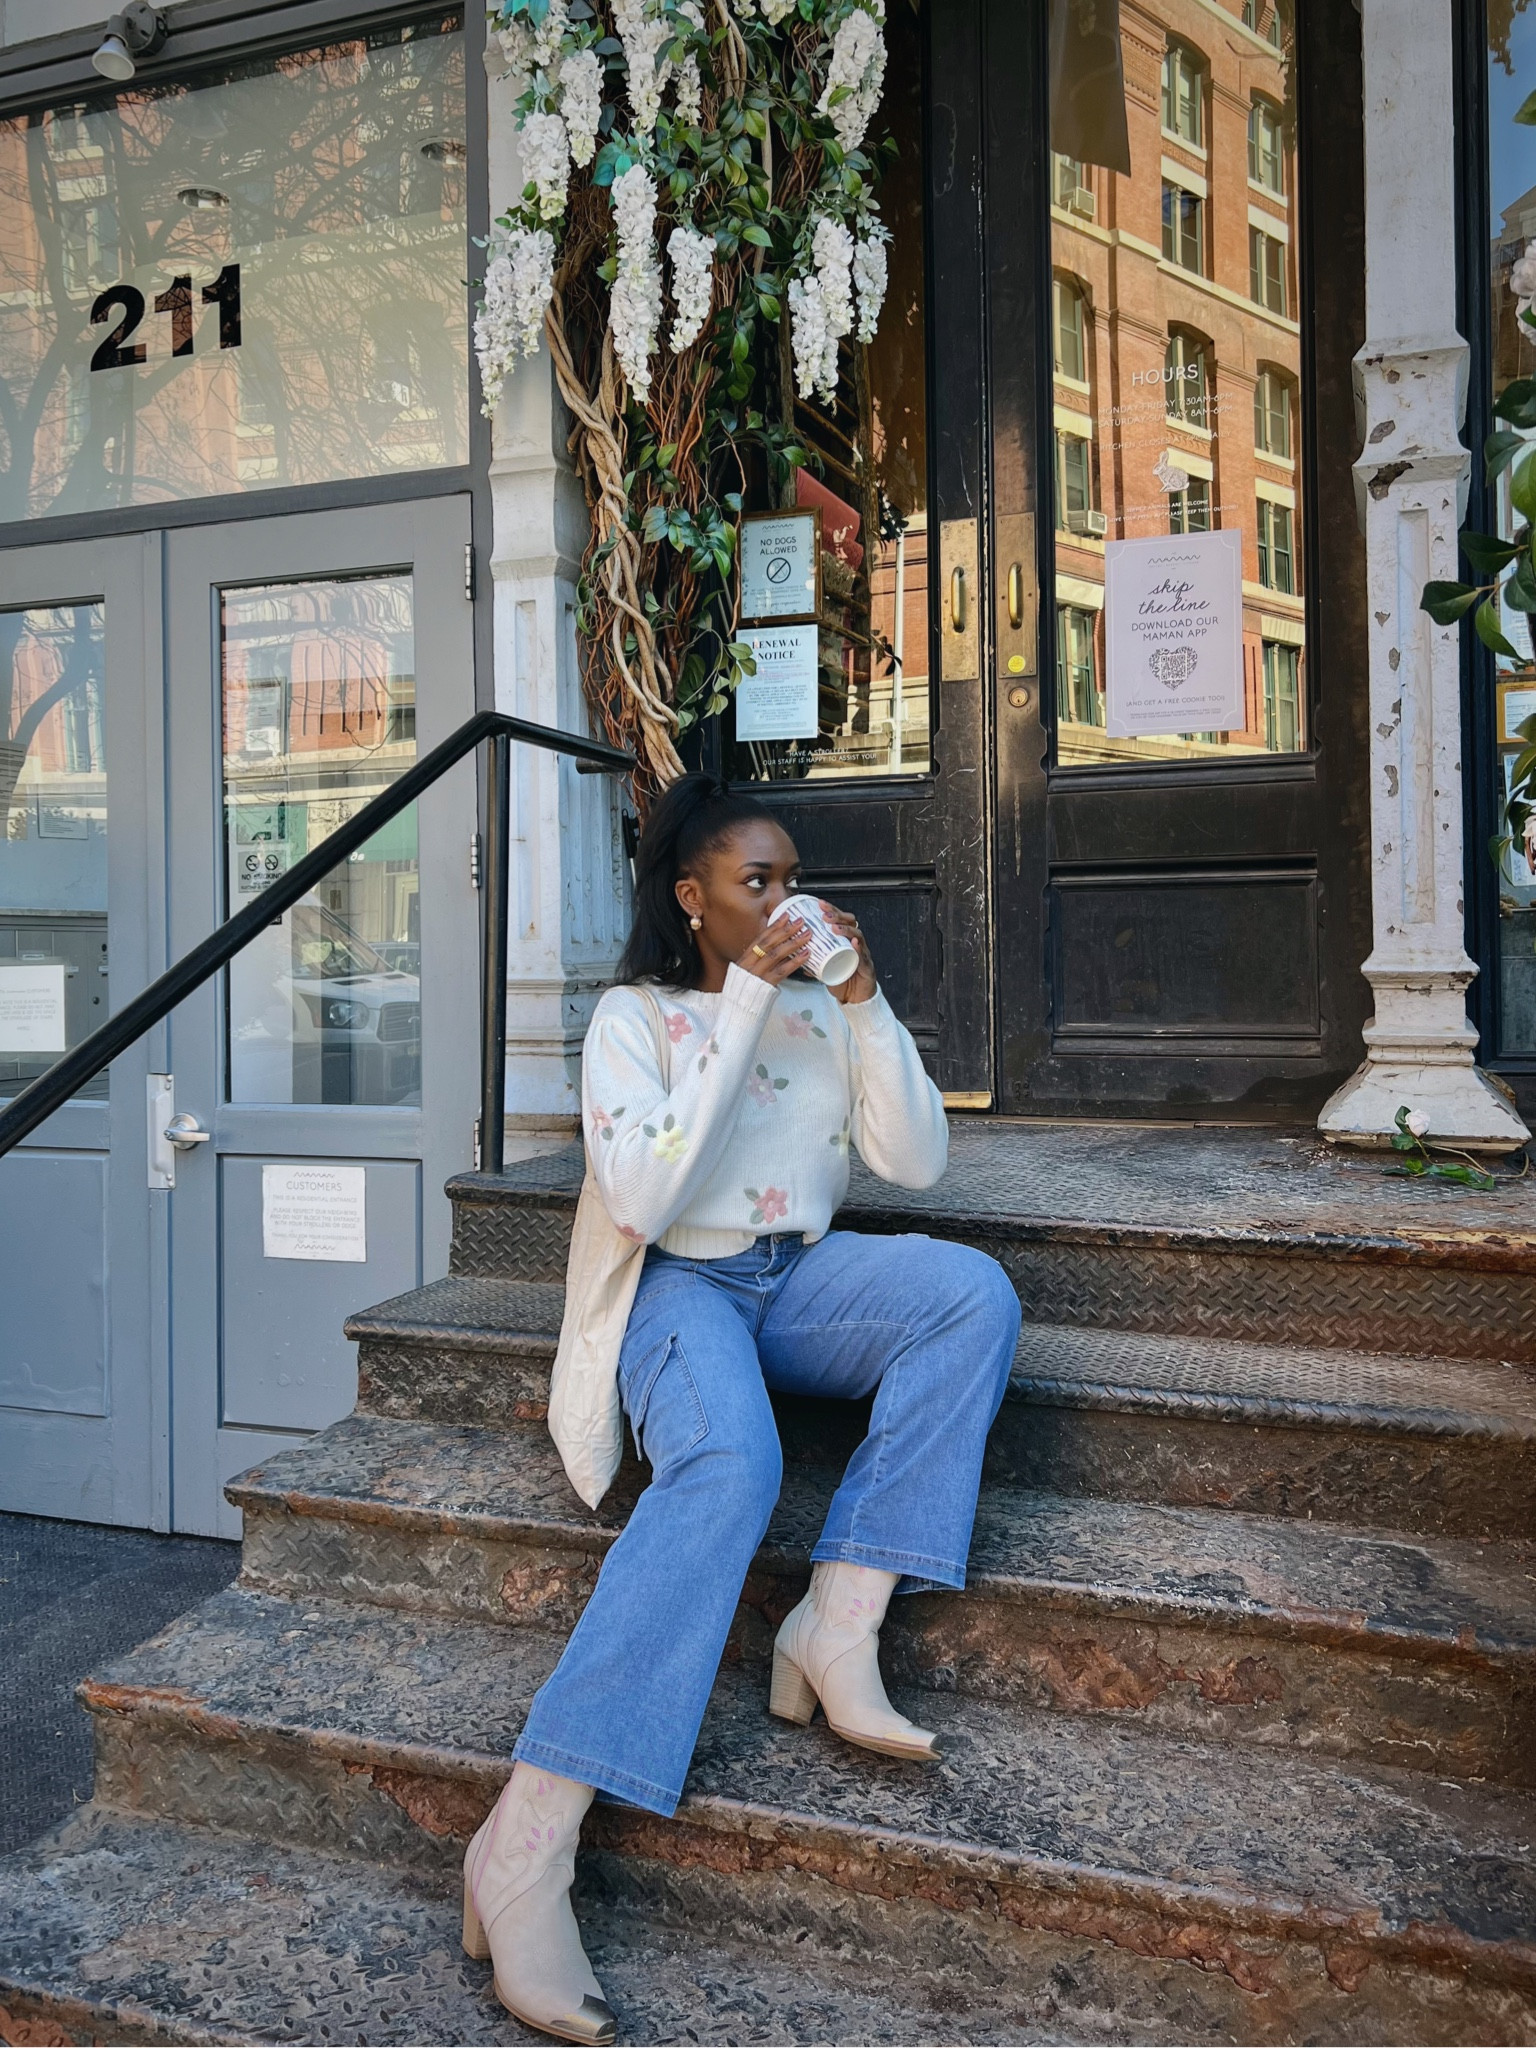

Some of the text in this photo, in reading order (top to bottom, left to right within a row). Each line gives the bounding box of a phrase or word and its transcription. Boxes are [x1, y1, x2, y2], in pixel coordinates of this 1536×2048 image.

[90, 263, 242, 372] 211
[1132, 364, 1198, 386] HOURS
[1180, 393, 1233, 407] 730AM-6PM
[1191, 405, 1233, 417] 8AM-6PM
[760, 536, 797, 546] NO DOGS
[760, 545, 798, 556] ALLOWED
[1148, 578, 1194, 599] skip
[1138, 597, 1210, 614] the line
[1131, 616, 1219, 631] DOWNLOAD OUR
[1143, 628, 1207, 641] MAMAN APP
[758, 650, 796, 660] NOTICE
[242, 873, 251, 881] NO
[286, 1180, 343, 1191] CUSTOMERS
